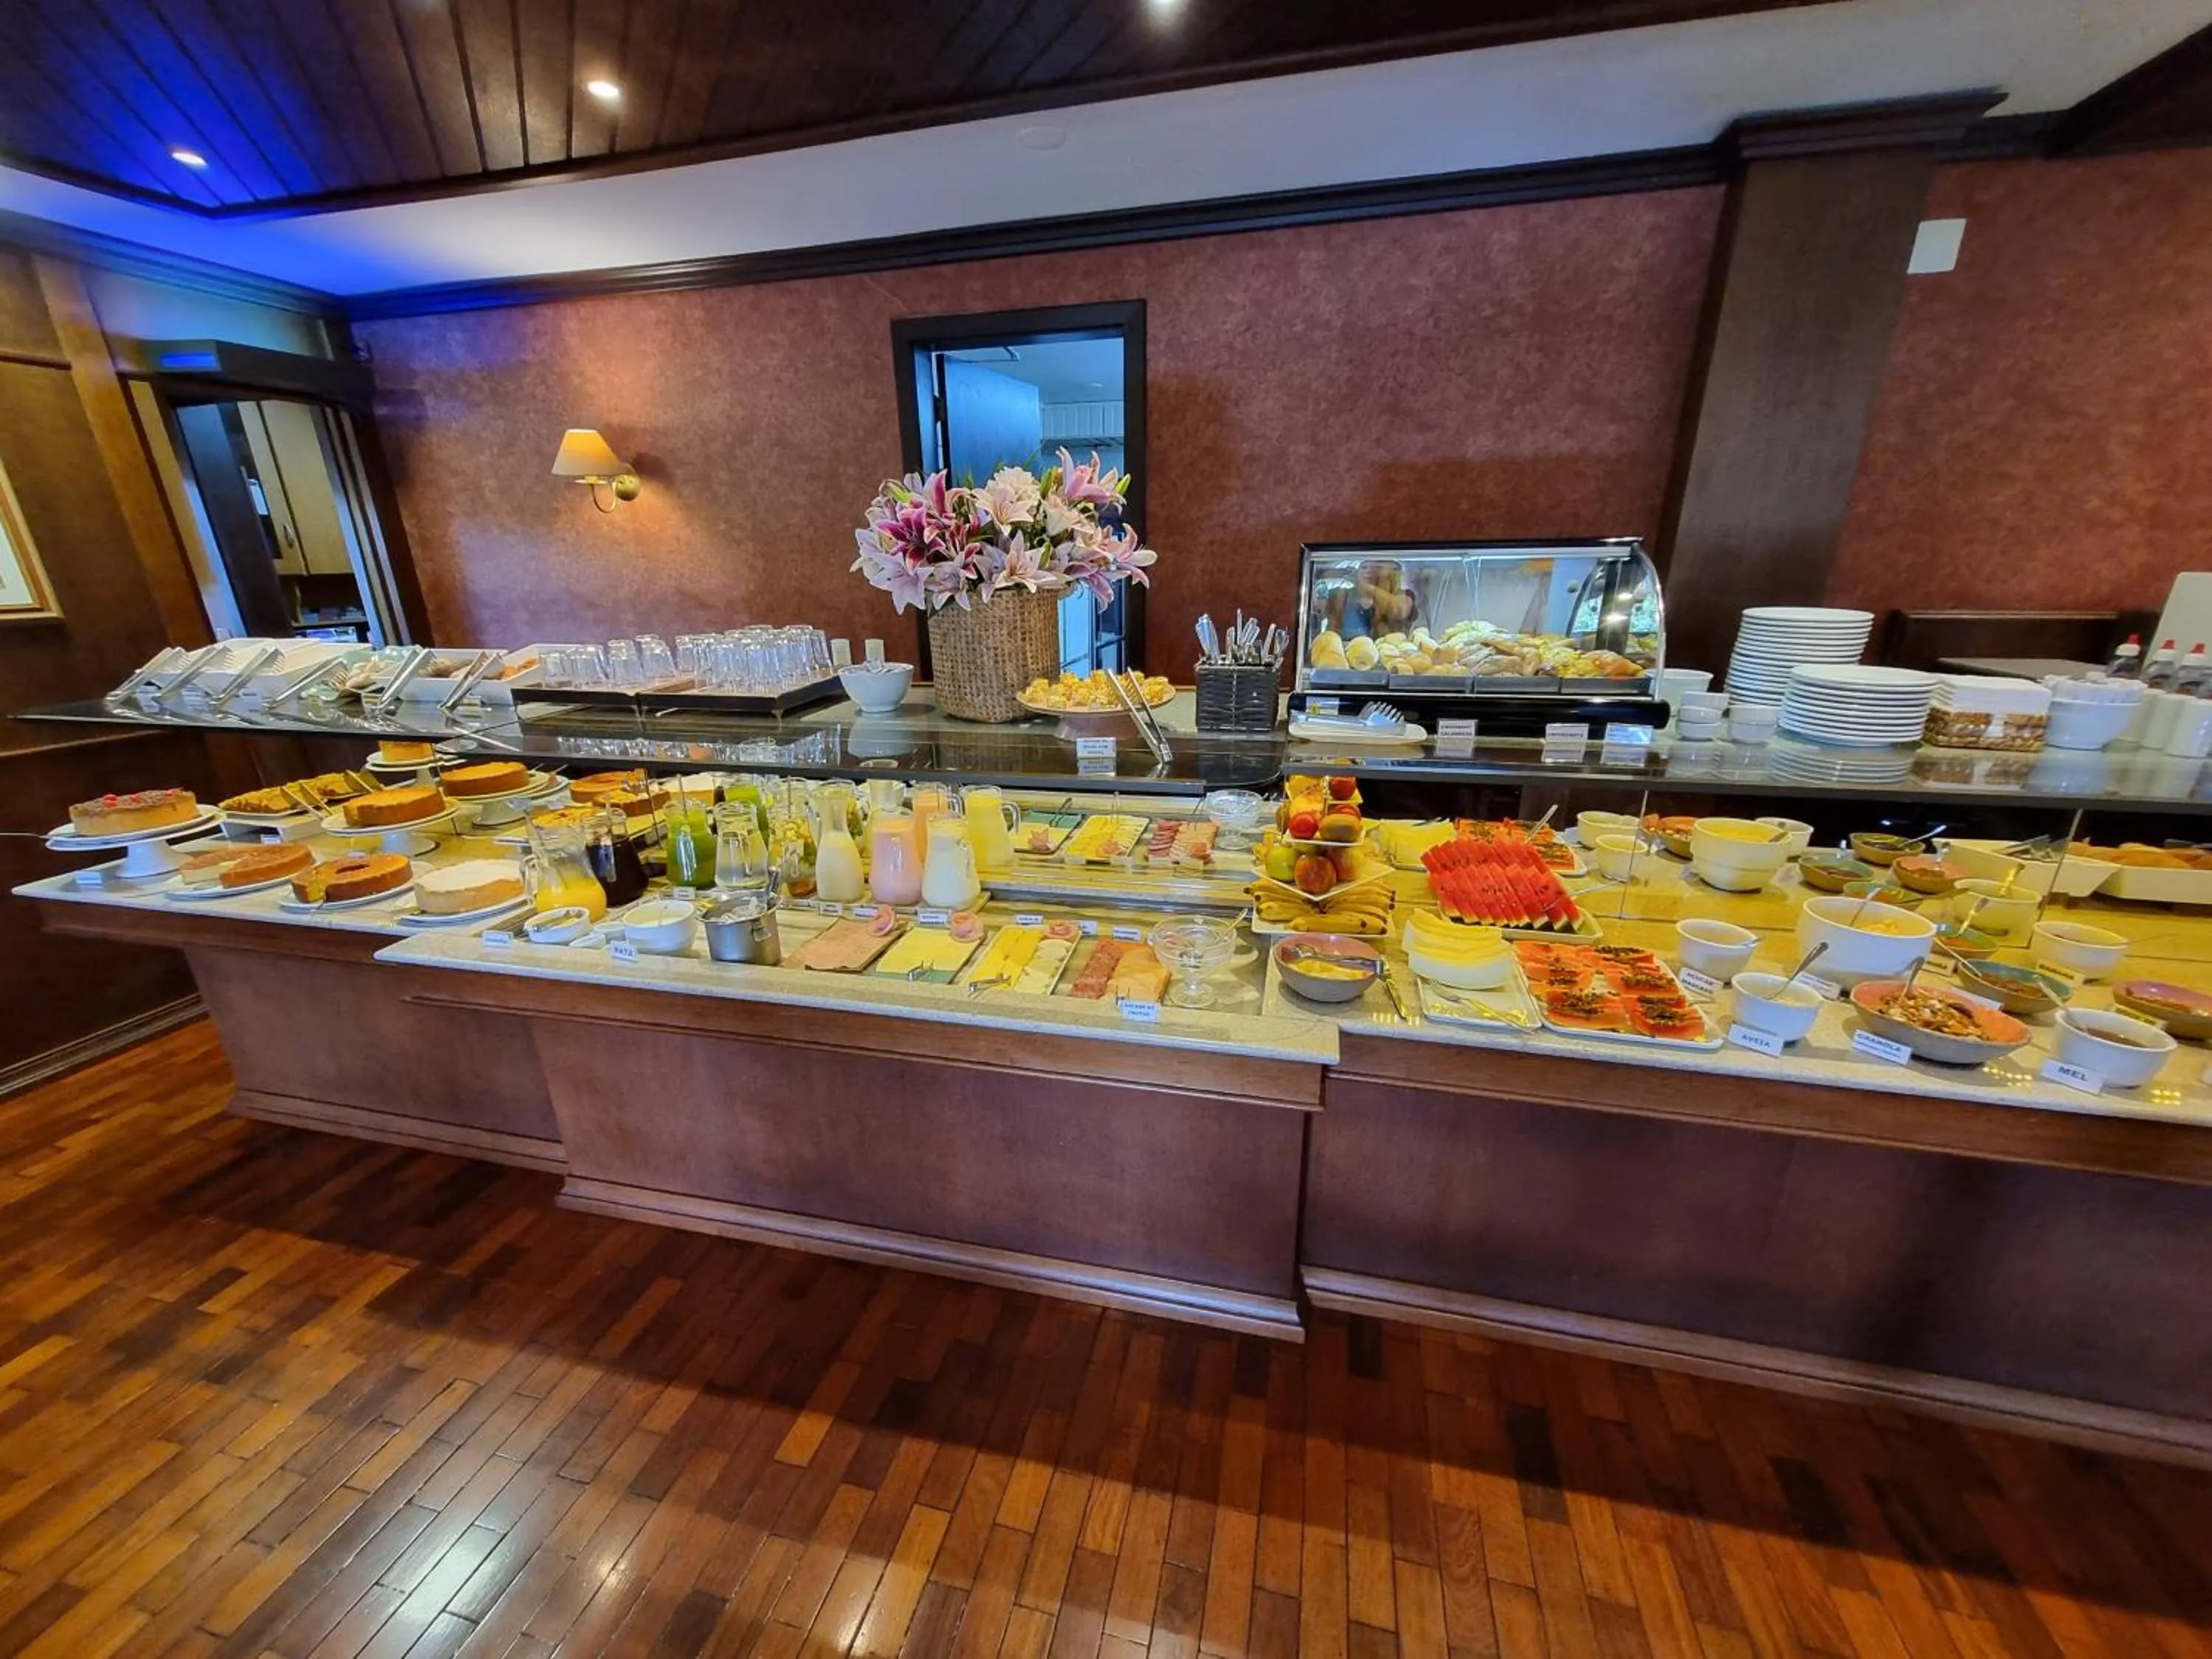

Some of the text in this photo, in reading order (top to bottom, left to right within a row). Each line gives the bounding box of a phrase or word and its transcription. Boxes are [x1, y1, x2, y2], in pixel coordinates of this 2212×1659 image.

[1741, 1034, 1771, 1048] AVEIA
[1857, 1033, 1901, 1052] GRANOLA
[2057, 1065, 2088, 1082] MEL
